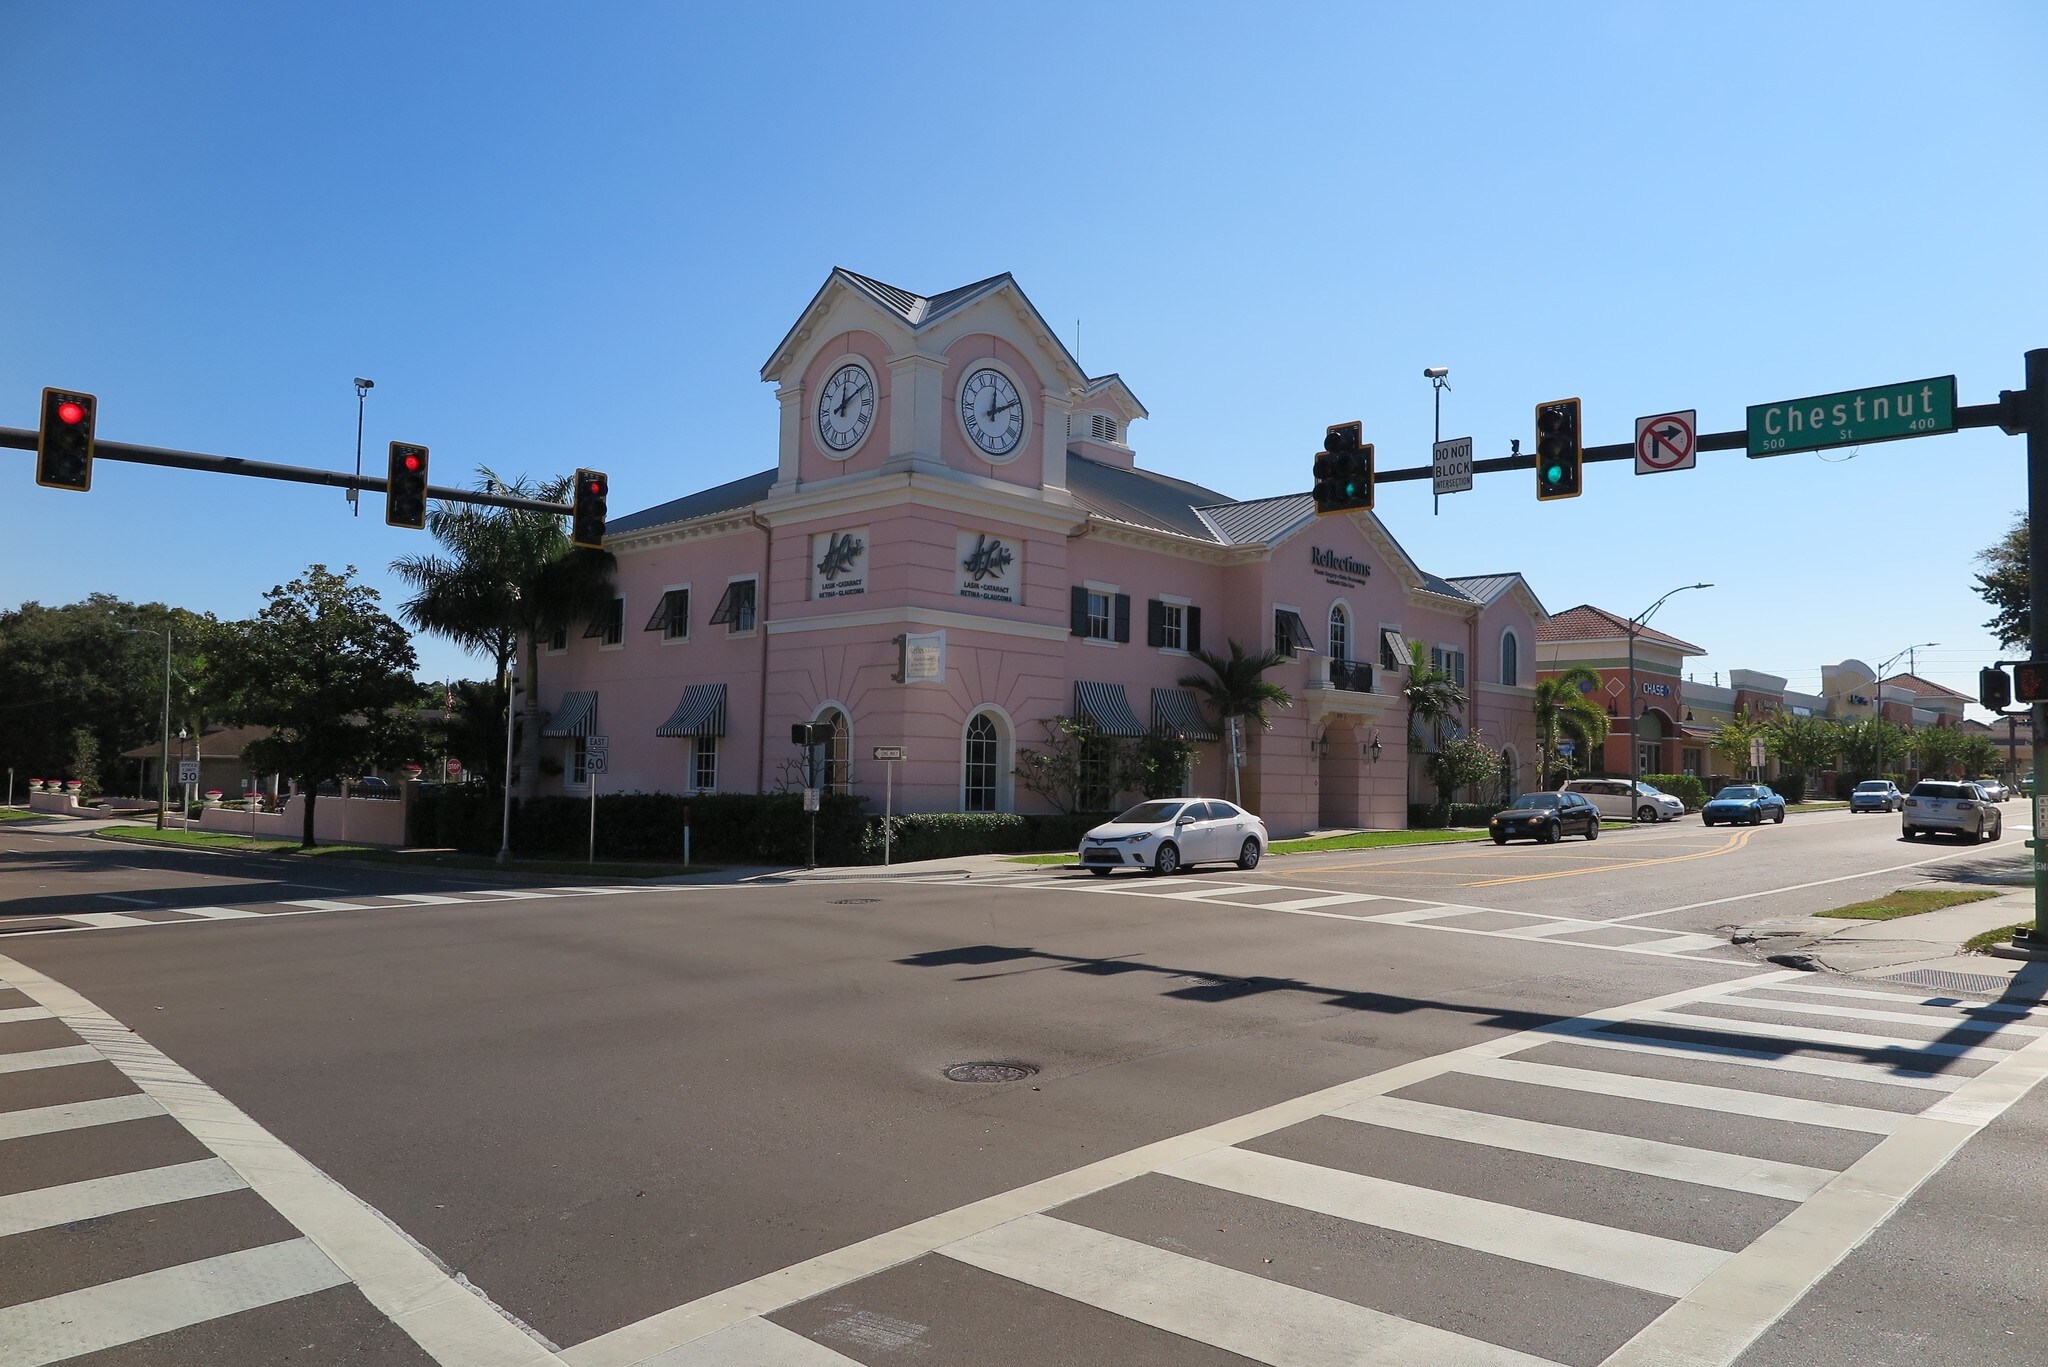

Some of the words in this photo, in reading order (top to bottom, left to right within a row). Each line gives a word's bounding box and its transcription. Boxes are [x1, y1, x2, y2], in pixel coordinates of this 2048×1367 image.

[1764, 385, 1934, 435] Chestnut
[1909, 417, 1935, 431] 400
[1839, 429, 1853, 440] St
[1762, 437, 1786, 450] 500
[1435, 448, 1449, 461] DO
[1451, 444, 1470, 458] NOT
[1436, 461, 1470, 478] BLOCK
[1311, 546, 1371, 576] Reflections
[963, 581, 980, 589] LASIK
[983, 583, 1010, 594] CATARACT
[983, 593, 1013, 603] GLAUCOMA
[1643, 682, 1664, 696] CHASE
[588, 758, 603, 769] 60
[181, 773, 197, 781] 30
